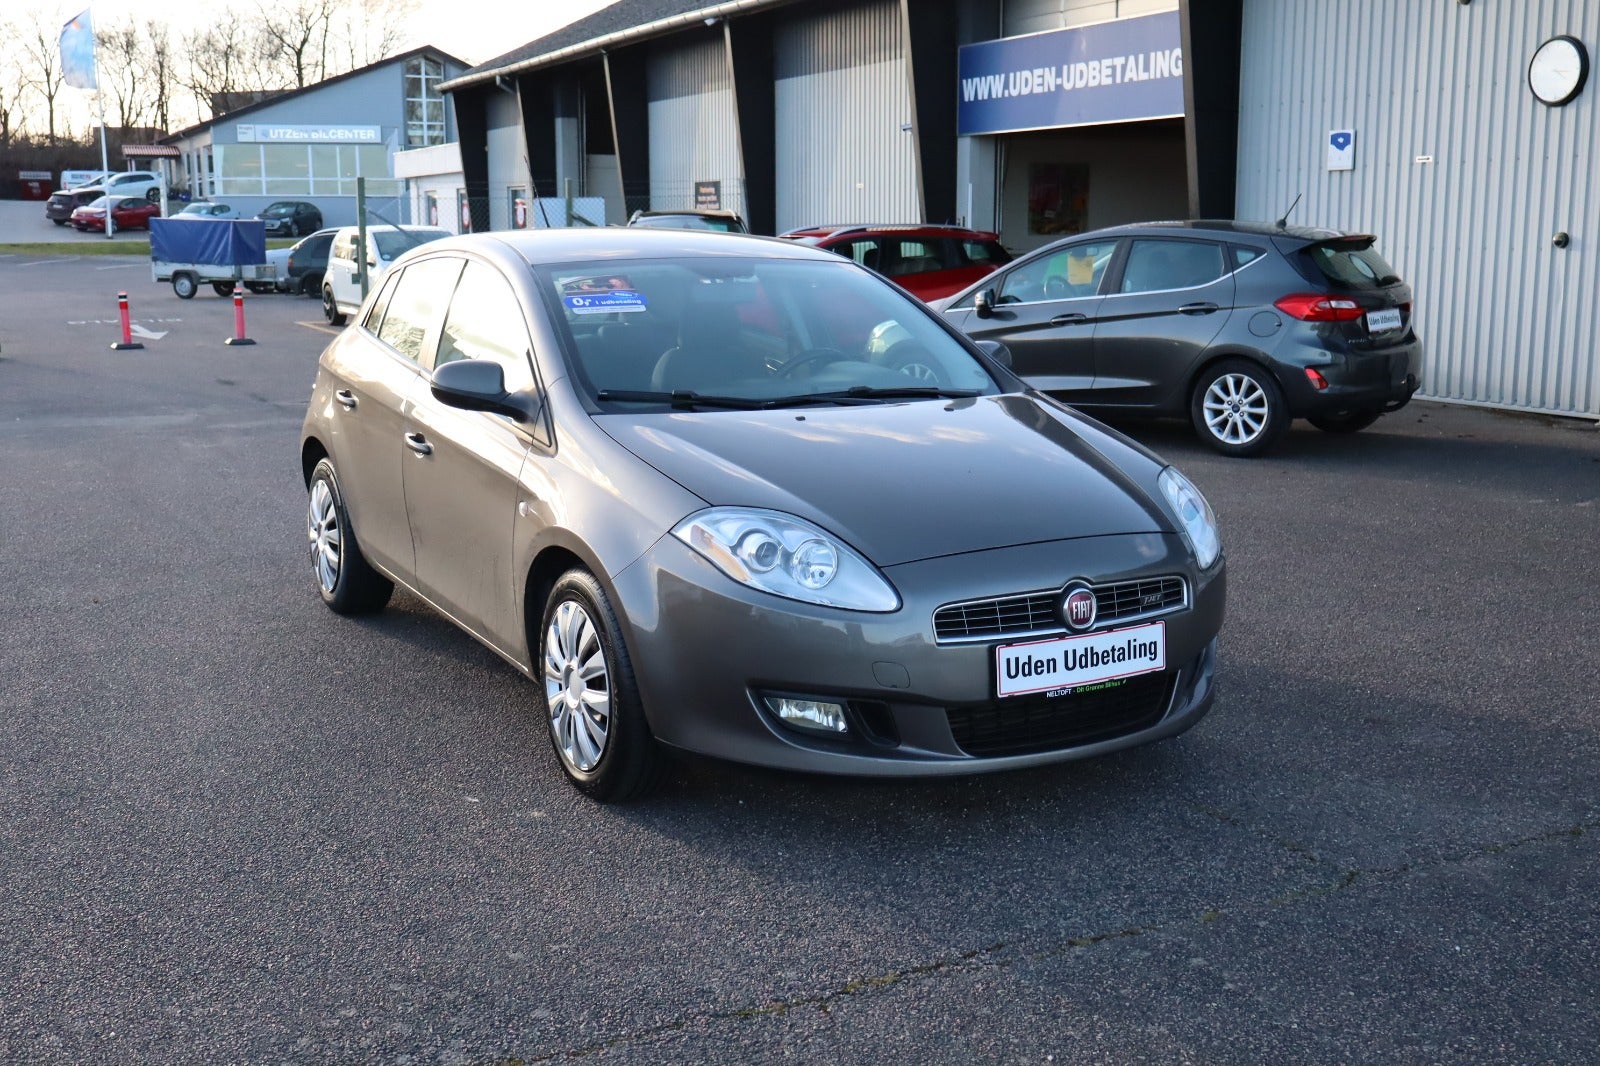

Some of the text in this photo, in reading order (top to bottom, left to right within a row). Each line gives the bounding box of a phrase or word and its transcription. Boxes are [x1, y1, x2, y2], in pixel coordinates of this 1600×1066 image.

[962, 48, 1184, 102] WWW.UDEN-UDBETALING
[1072, 599, 1092, 620] FIAT
[1005, 638, 1159, 680] Uden Udbetaling
[1046, 688, 1073, 698] NELTOFT
